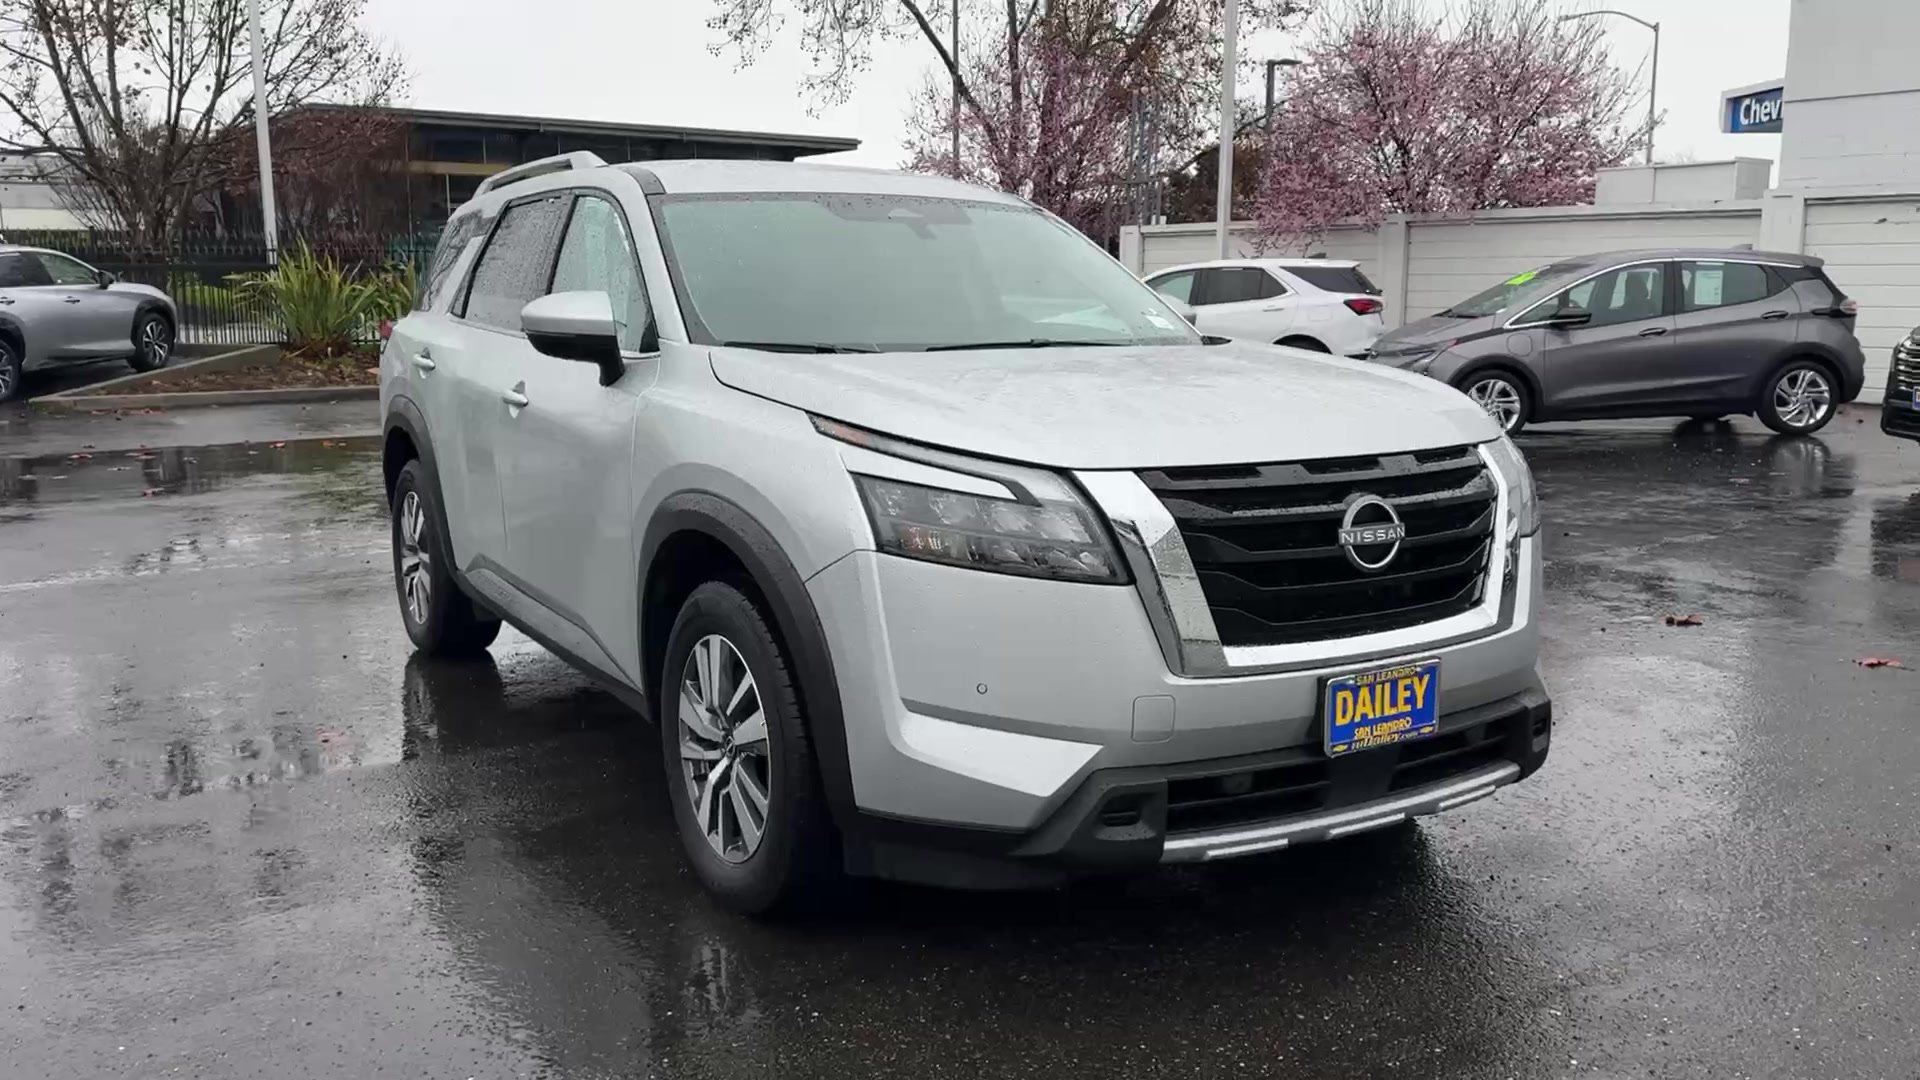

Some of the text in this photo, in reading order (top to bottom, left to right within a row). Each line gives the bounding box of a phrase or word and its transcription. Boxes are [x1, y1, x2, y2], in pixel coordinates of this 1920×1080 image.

[1341, 527, 1405, 543] NISSAN
[1356, 666, 1416, 684] SAN LEANDRO
[1335, 673, 1430, 726] DAILEY
[1354, 726, 1371, 739] SAN
